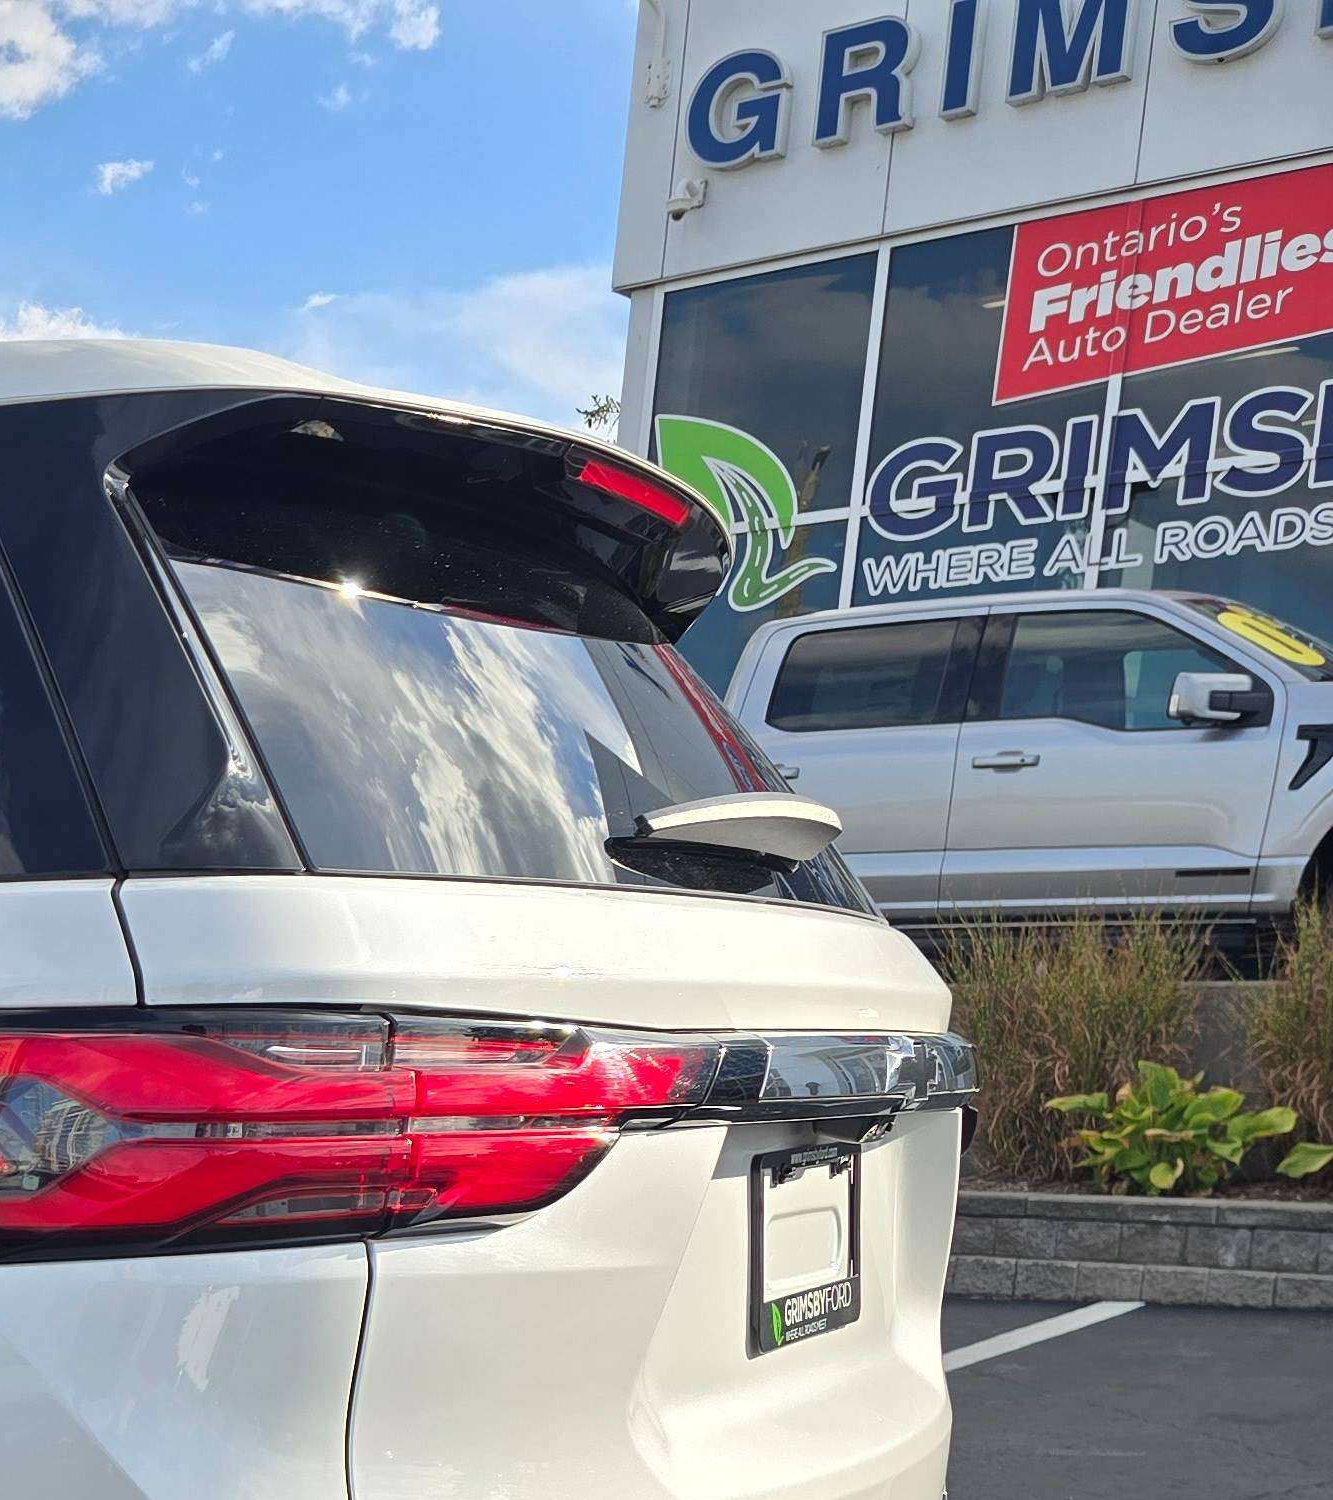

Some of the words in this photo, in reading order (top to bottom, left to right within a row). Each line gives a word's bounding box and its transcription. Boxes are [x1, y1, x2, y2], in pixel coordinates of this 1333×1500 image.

[1037, 202, 1243, 278] Ontario's
[1022, 325, 1127, 373] Auto
[1144, 286, 1294, 345] Dealer
[865, 378, 1333, 542] GRIMS
[863, 537, 1039, 597] WHERE
[1042, 526, 1146, 578] ALL
